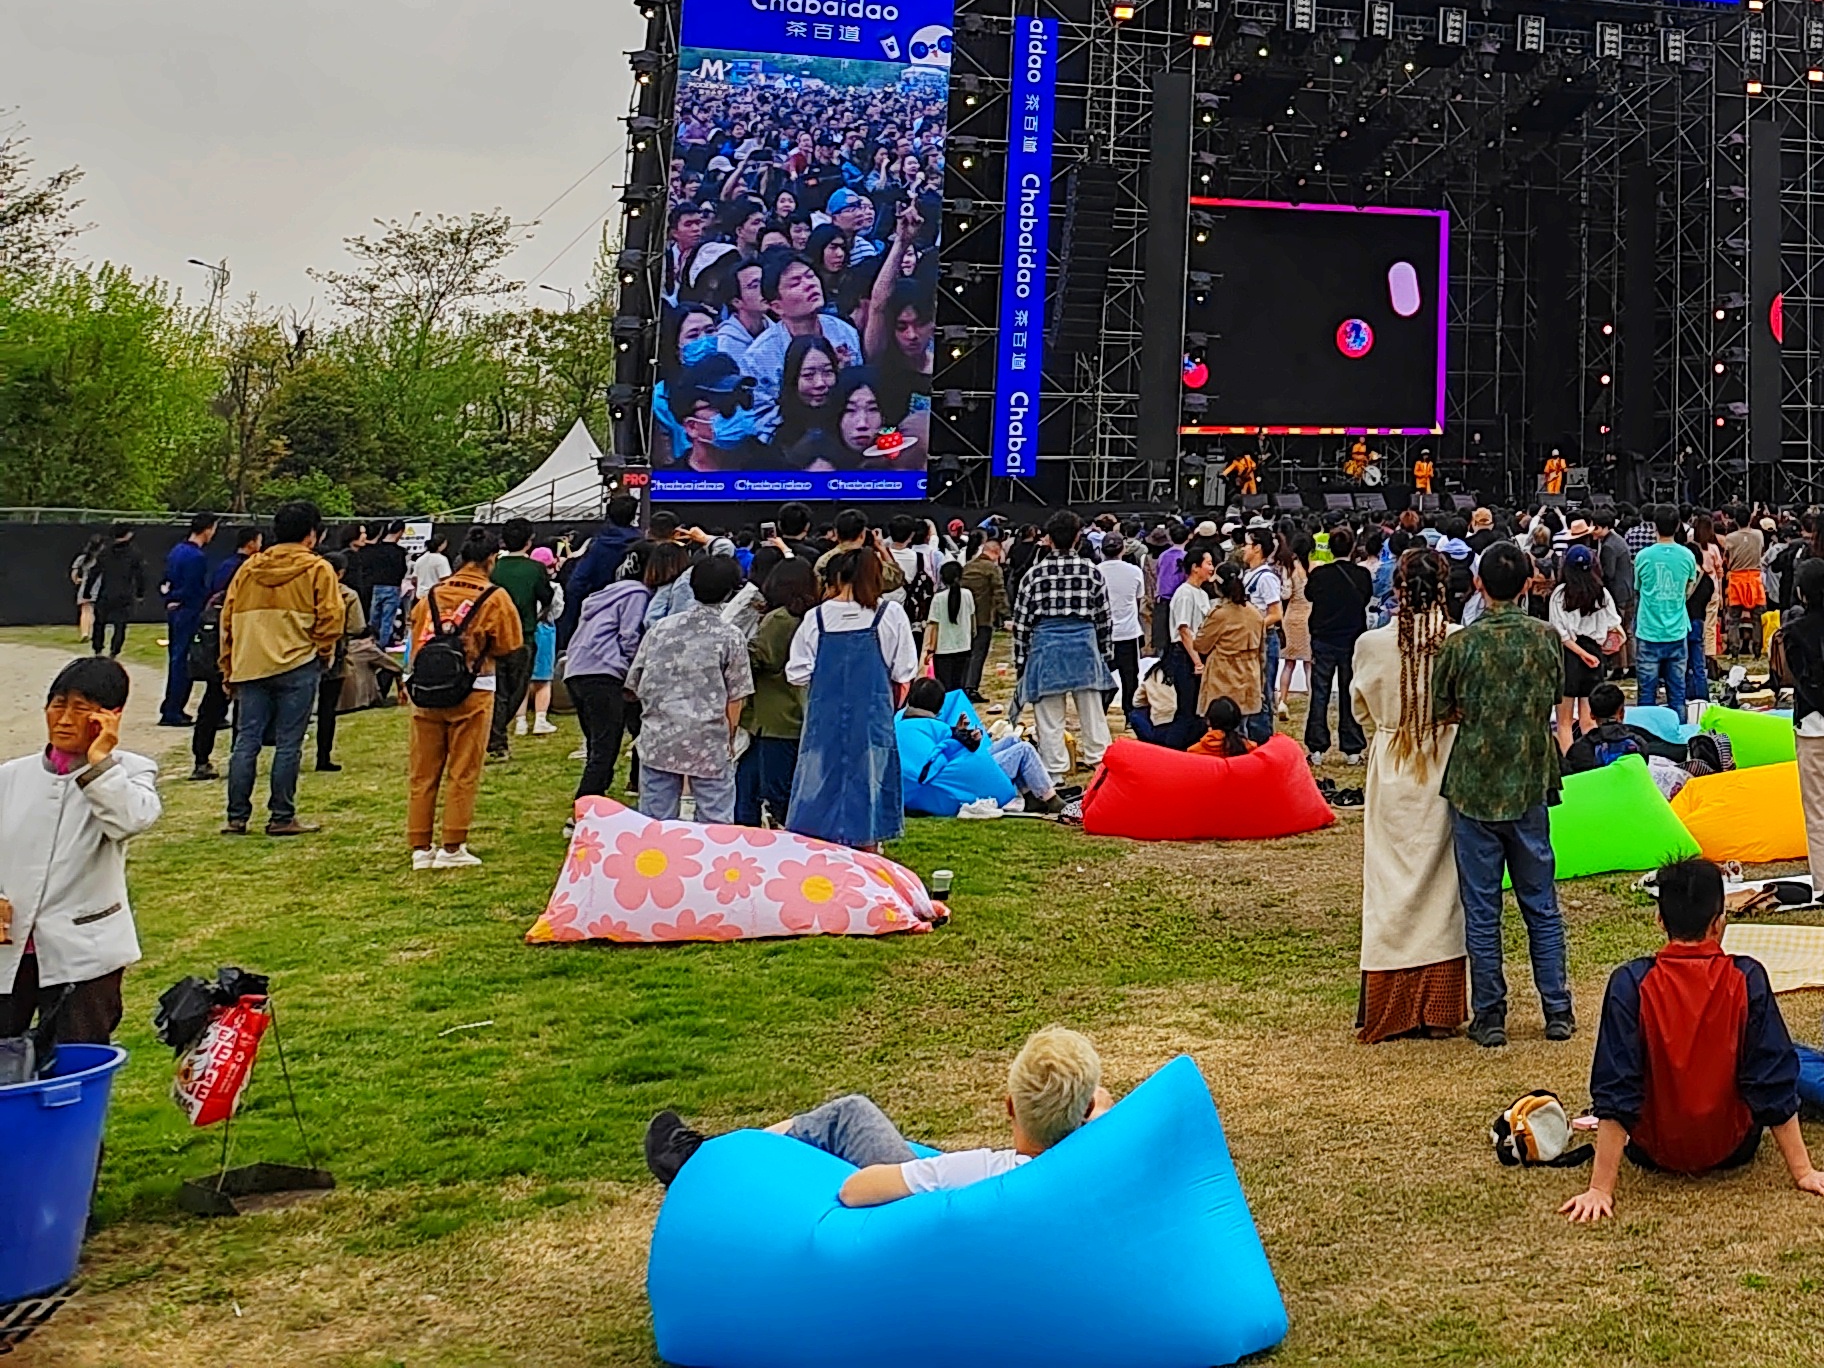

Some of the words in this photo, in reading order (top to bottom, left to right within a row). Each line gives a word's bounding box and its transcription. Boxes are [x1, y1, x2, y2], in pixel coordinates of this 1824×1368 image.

[785, 21, 861, 43] 茶百道
[1022, 94, 1040, 154] 茶百道
[1016, 173, 1041, 299] Chabaidao
[1011, 309, 1029, 371] 茶百道
[1006, 391, 1030, 478] Chabai
[623, 473, 649, 486] PRO
